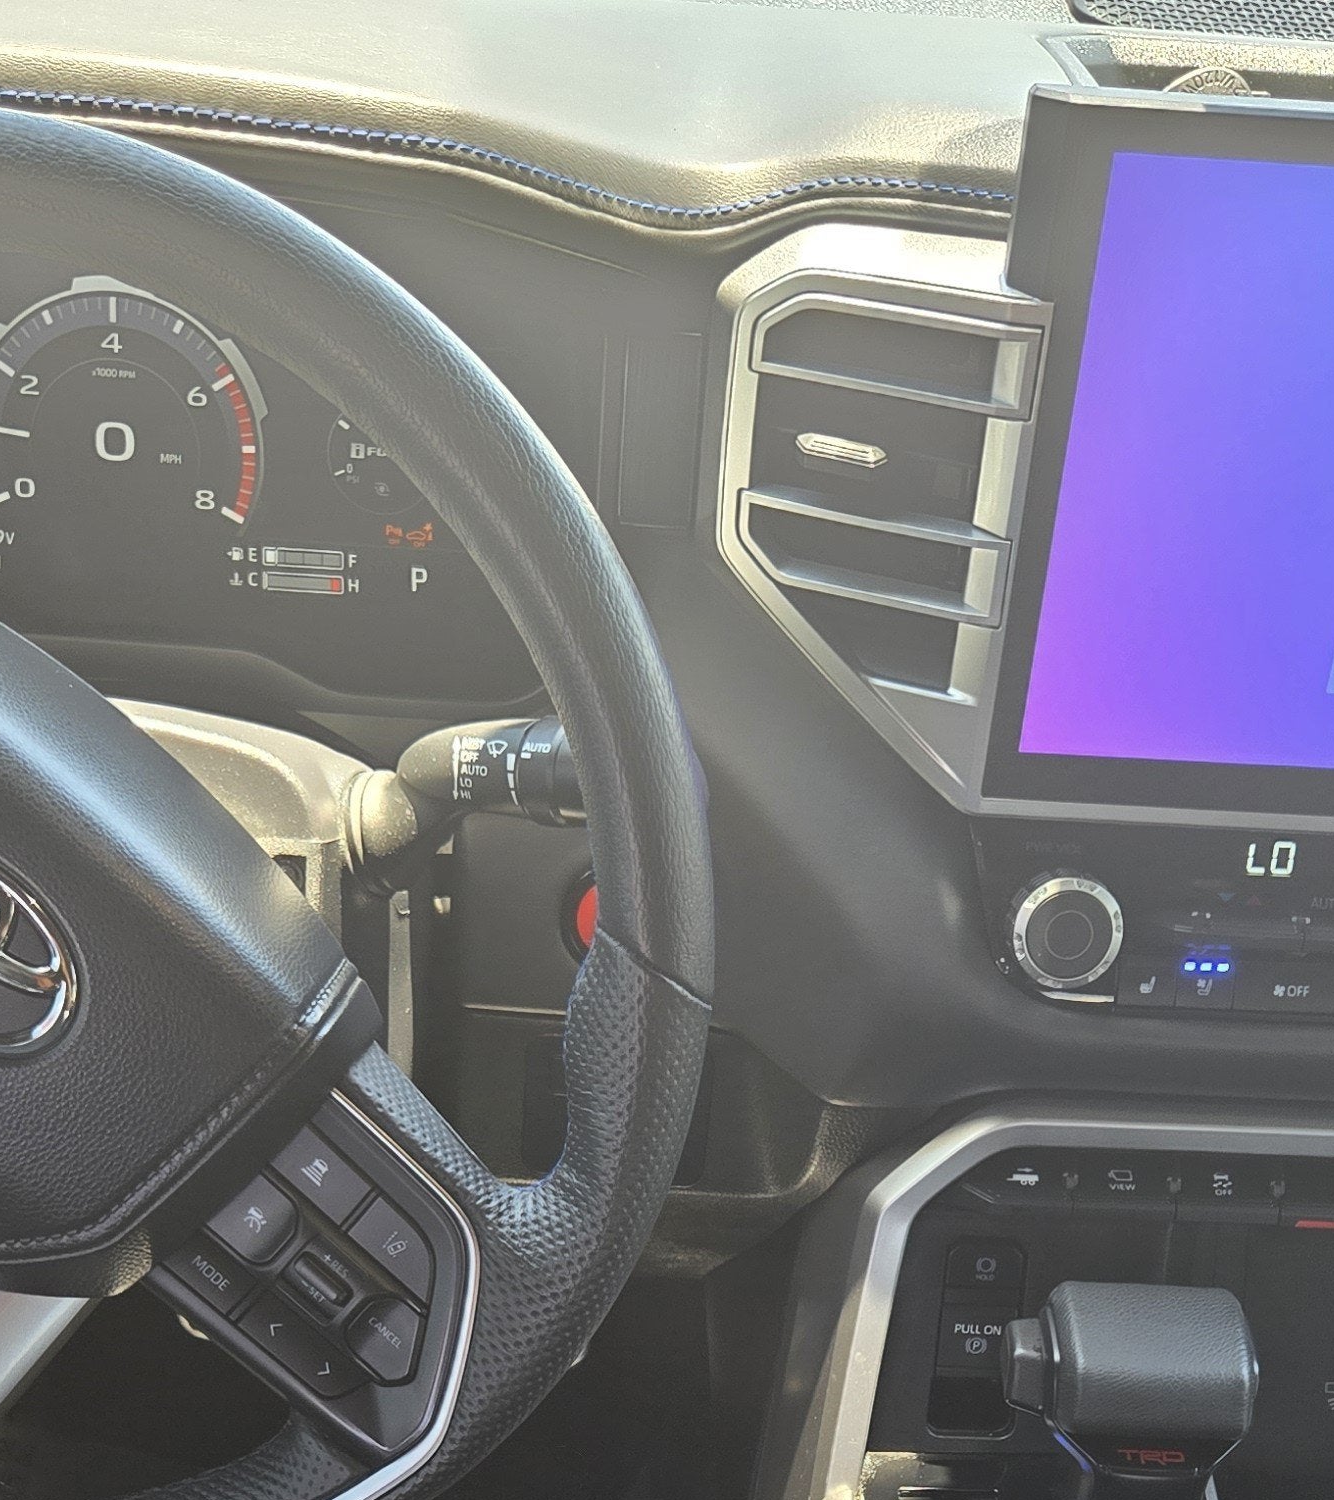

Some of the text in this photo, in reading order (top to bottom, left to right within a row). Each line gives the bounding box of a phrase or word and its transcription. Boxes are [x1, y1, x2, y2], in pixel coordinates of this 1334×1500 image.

[100, 332, 123, 353] 4
[118, 369, 136, 379] RPM
[19, 375, 40, 395] 2
[186, 386, 208, 407] 6
[95, 421, 135, 461] 0
[159, 453, 182, 465] MPH
[346, 463, 353, 474] 0
[14, 477, 36, 498] 0
[194, 489, 215, 510] 8
[247, 548, 257, 562] E
[348, 554, 358, 568] F
[247, 572, 258, 587] C
[348, 578, 359, 593] H
[410, 567, 428, 592] P
[522, 742, 551, 754] AUTO
[460, 764, 488, 777] AUTO
[459, 777, 473, 789] LO
[460, 789, 472, 800] HI
[1246, 841, 1297, 876] LO
[1287, 985, 1310, 998] OFF
[1108, 1183, 1136, 1191] VIEW
[1214, 1188, 1233, 1197] OFF
[192, 1255, 230, 1291] MODE
[368, 1316, 403, 1349] CANCEL
[954, 1323, 1002, 1336] PULL ON
[1116, 1449, 1186, 1466] TRD
